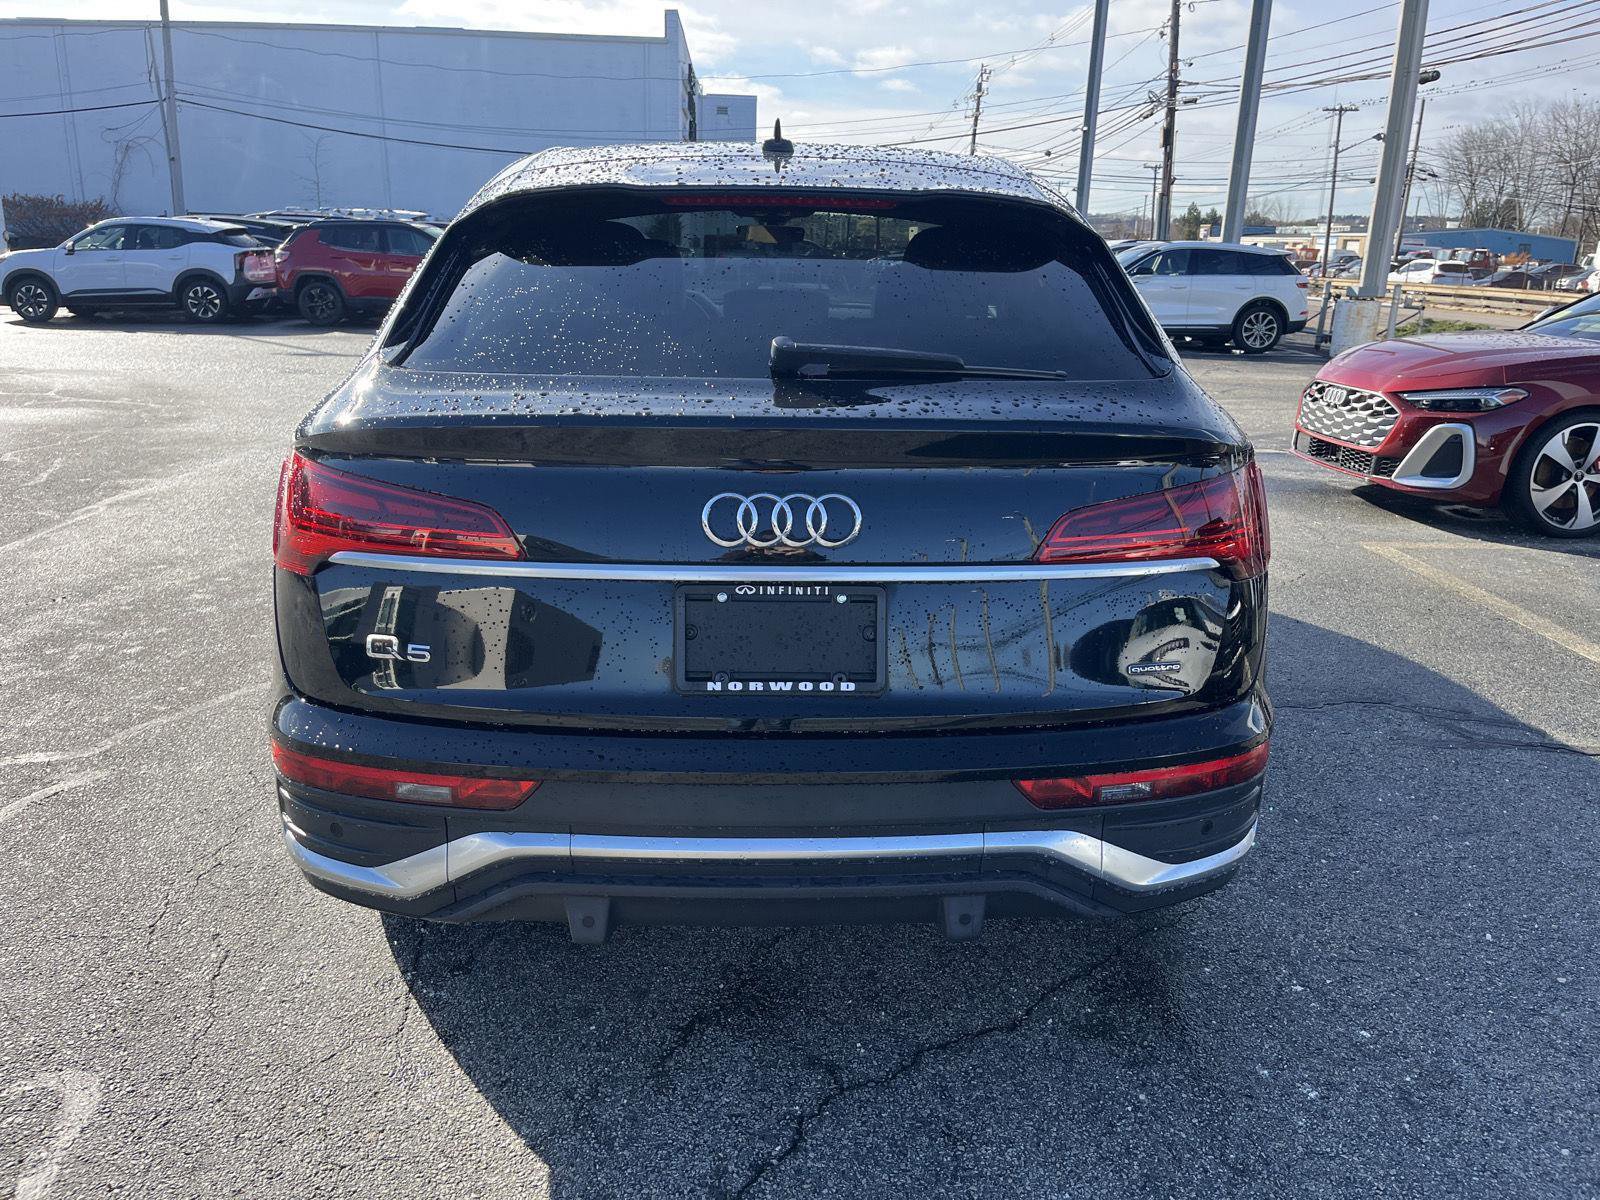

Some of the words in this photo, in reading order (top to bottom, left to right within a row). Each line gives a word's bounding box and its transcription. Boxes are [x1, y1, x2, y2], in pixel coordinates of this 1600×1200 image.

[759, 585, 829, 596] INFINITI
[1131, 664, 1180, 673] quattro
[706, 681, 856, 692] NORWOOD
